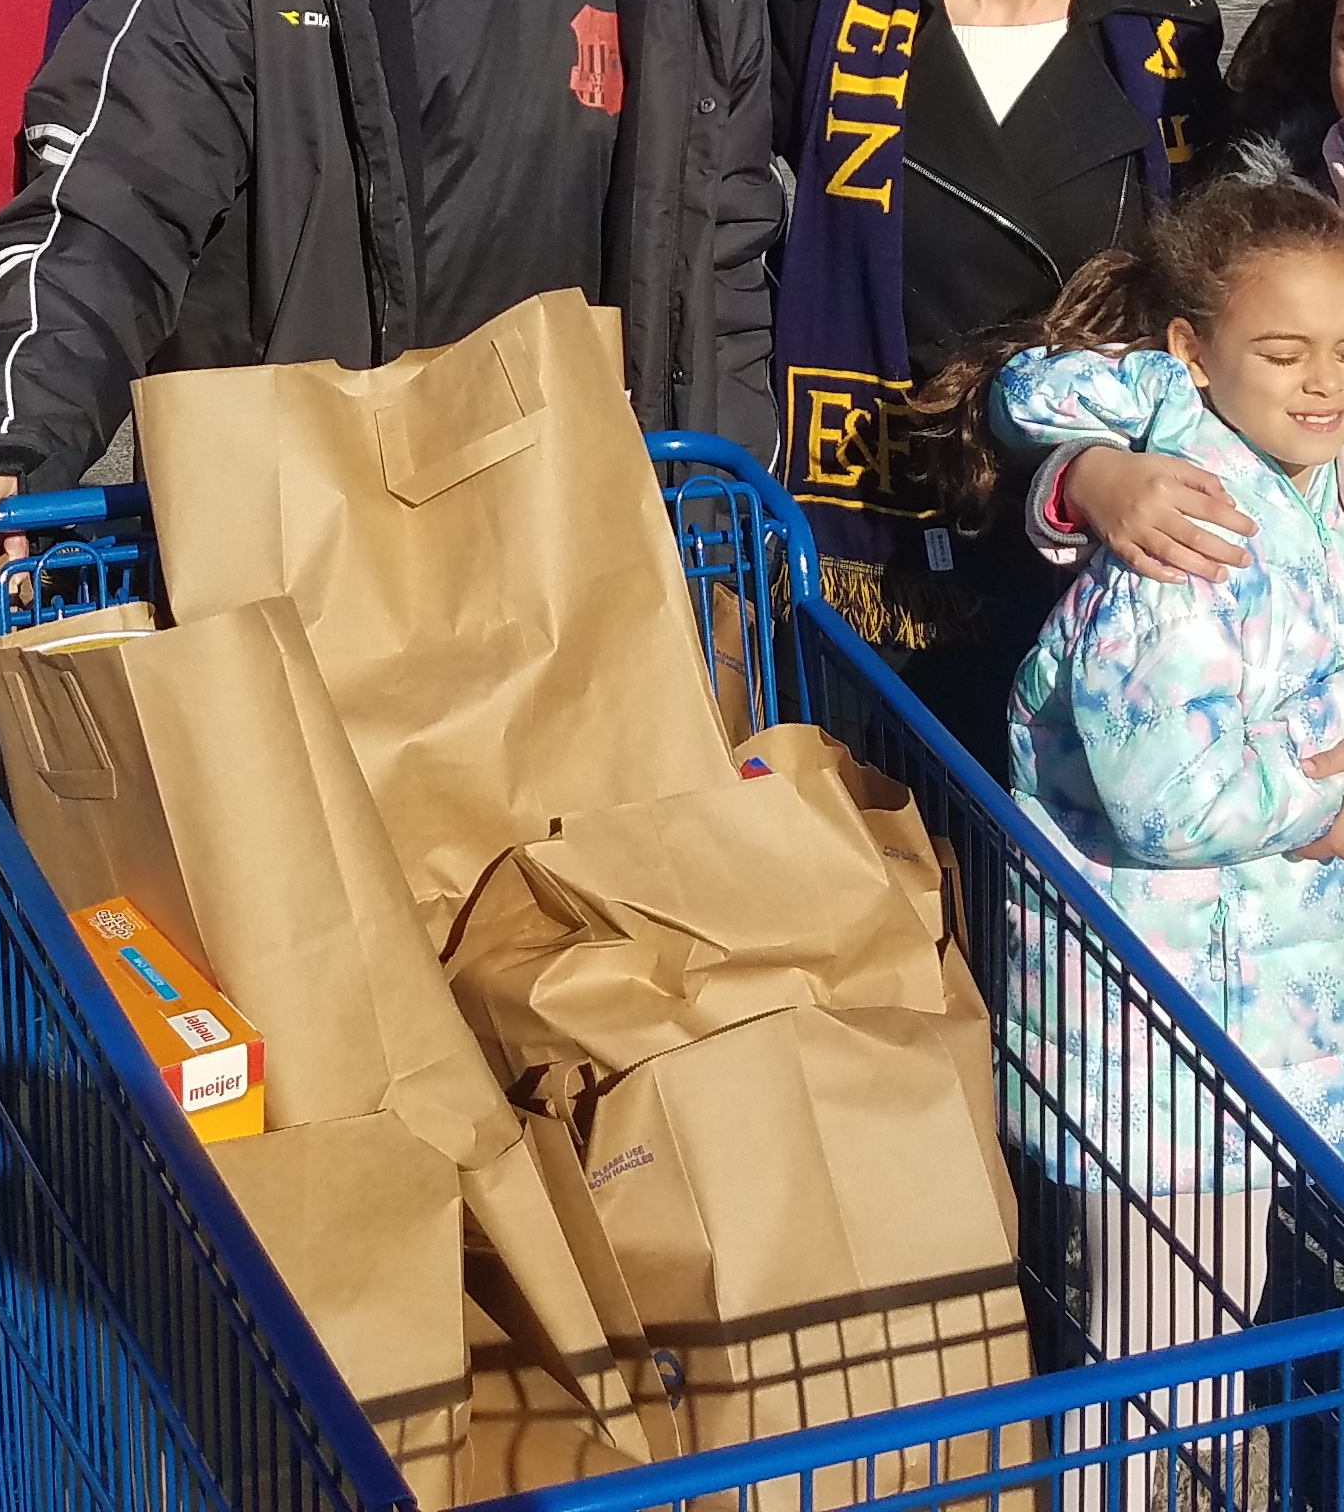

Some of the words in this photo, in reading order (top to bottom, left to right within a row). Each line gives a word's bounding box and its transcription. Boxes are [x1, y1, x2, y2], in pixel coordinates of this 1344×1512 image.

[183, 1014, 216, 1043] meijer
[189, 1073, 243, 1101] meijer
[588, 1173, 612, 1190] BOTH
[612, 1152, 654, 1176] HANDLES
[592, 1154, 625, 1179] PLEASE
[625, 1144, 645, 1159] USE
